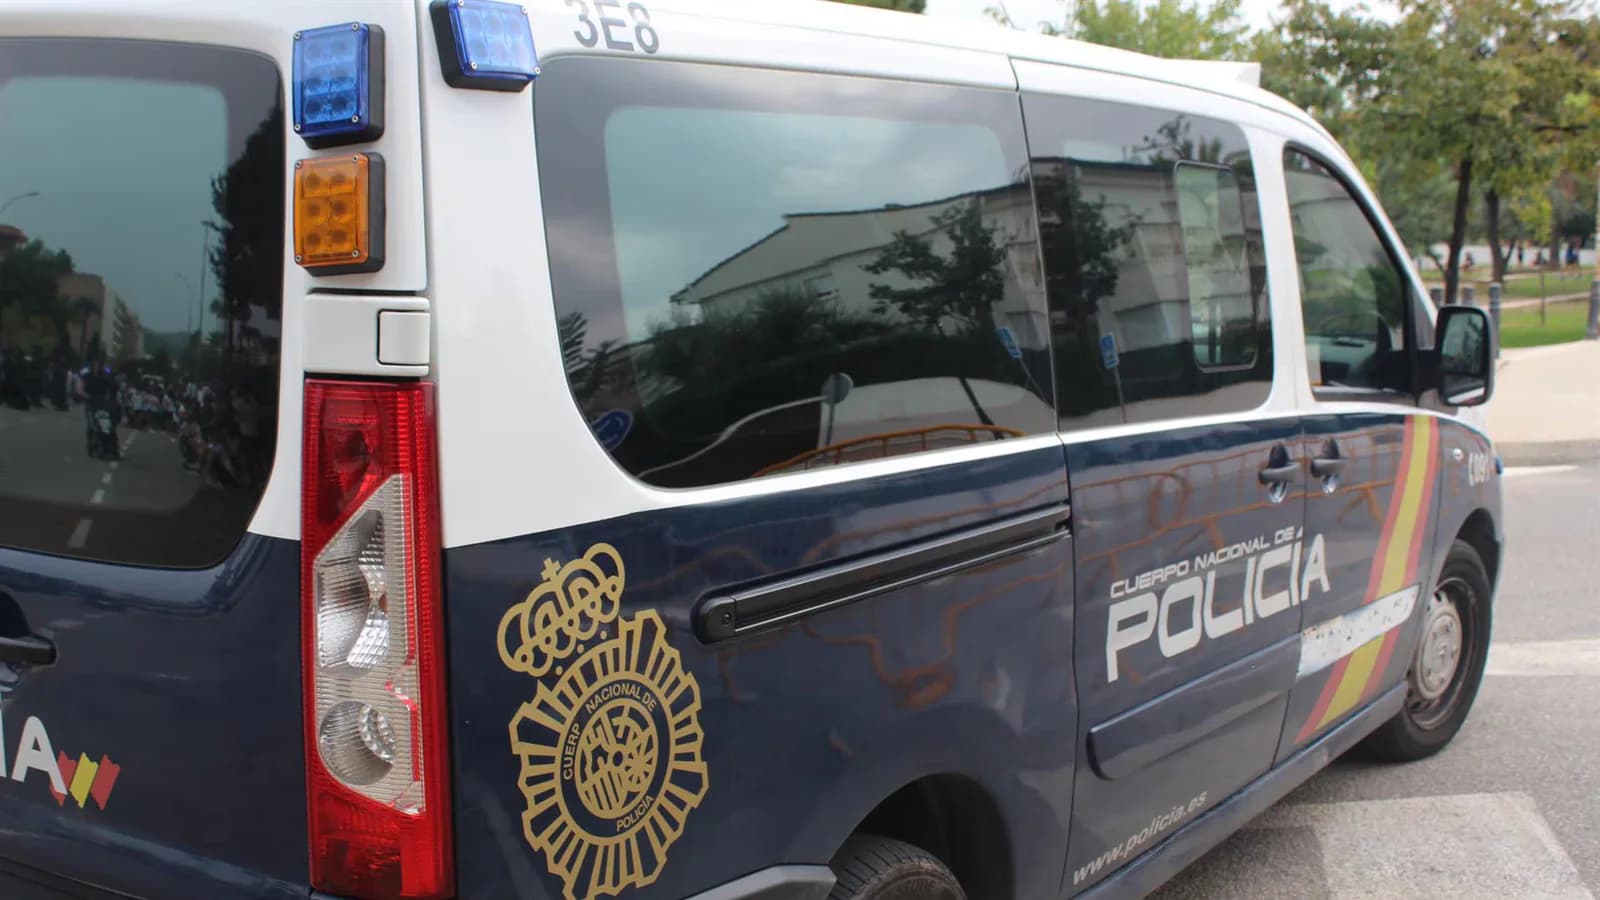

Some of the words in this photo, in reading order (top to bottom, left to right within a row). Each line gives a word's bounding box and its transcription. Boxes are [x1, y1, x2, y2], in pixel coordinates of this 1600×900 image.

[564, 0, 659, 54] 3E8
[1110, 561, 1189, 599] CUERPO
[1194, 535, 1271, 570] NACIONAL
[1274, 525, 1295, 545] DE
[1106, 526, 1331, 683] POLICÍA
[585, 683, 641, 714] NACIONAL
[642, 691, 657, 712] DE
[616, 795, 655, 832] POLICIA
[1073, 791, 1208, 885] www.policia.es
